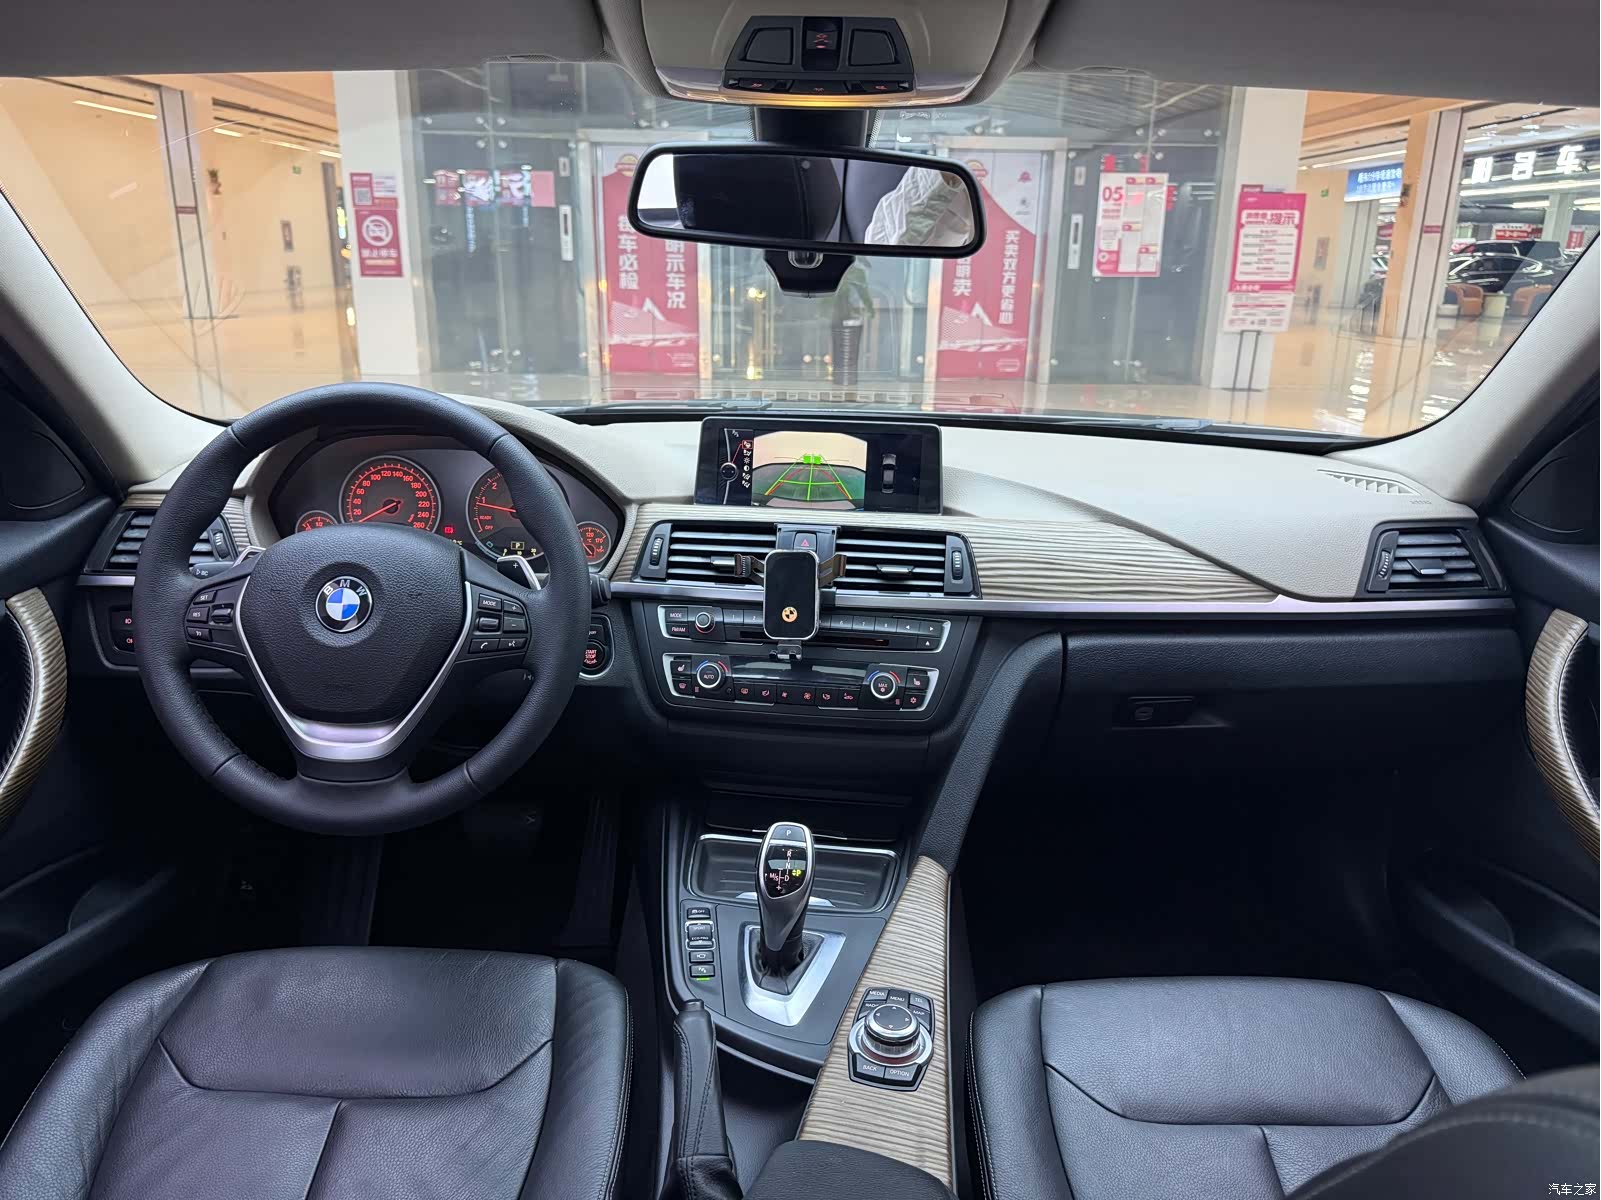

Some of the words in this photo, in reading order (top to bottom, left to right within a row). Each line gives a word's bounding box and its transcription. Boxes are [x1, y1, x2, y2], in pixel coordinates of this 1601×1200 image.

[1103, 187, 1124, 202] 05
[998, 230, 1020, 325] 买卖双方更省心
[323, 579, 368, 597] BMW
[786, 850, 792, 858] R
[784, 874, 790, 882] D
[862, 1064, 877, 1072] BACK
[889, 1068, 910, 1077] OPTION
